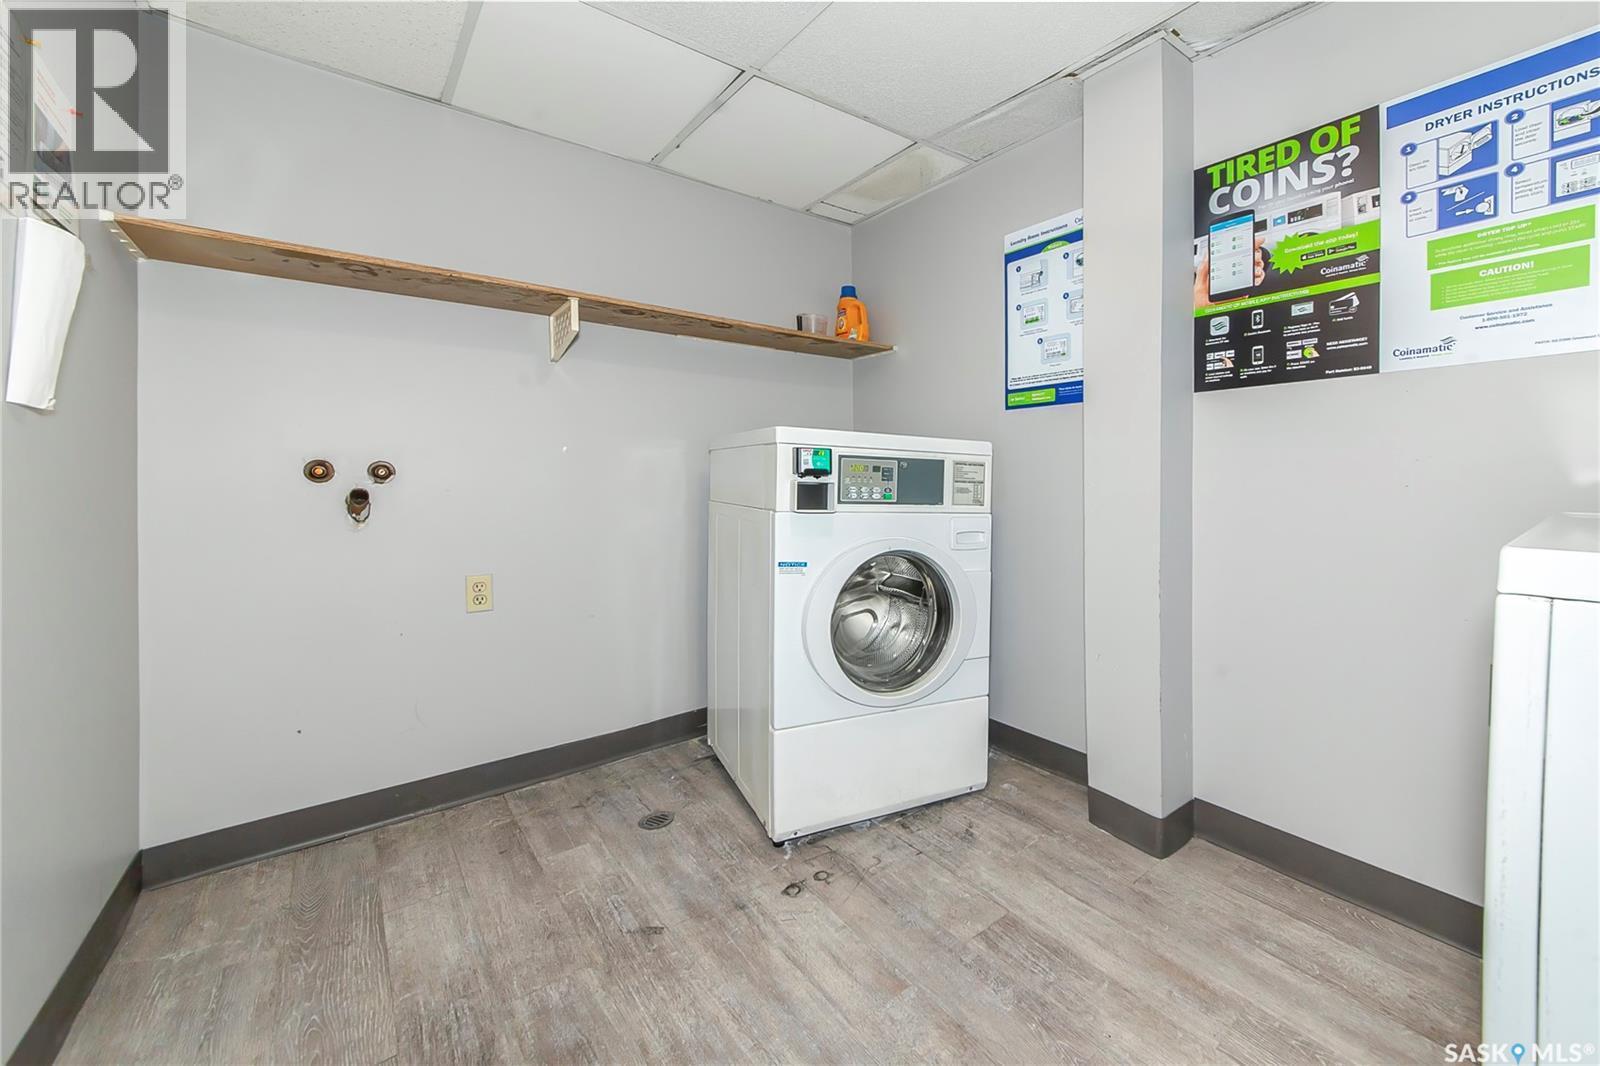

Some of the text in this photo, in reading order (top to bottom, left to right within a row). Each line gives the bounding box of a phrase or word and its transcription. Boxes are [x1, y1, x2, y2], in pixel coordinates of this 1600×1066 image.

[1425, 109, 1473, 132] DRYER
[1207, 115, 1361, 190] TIRED OF
[1208, 145, 1360, 215] COINS?
[1320, 260, 1367, 276] Coinamatic
[1479, 261, 1534, 277] CAUTION!
[1393, 342, 1453, 358] Coinamatic
